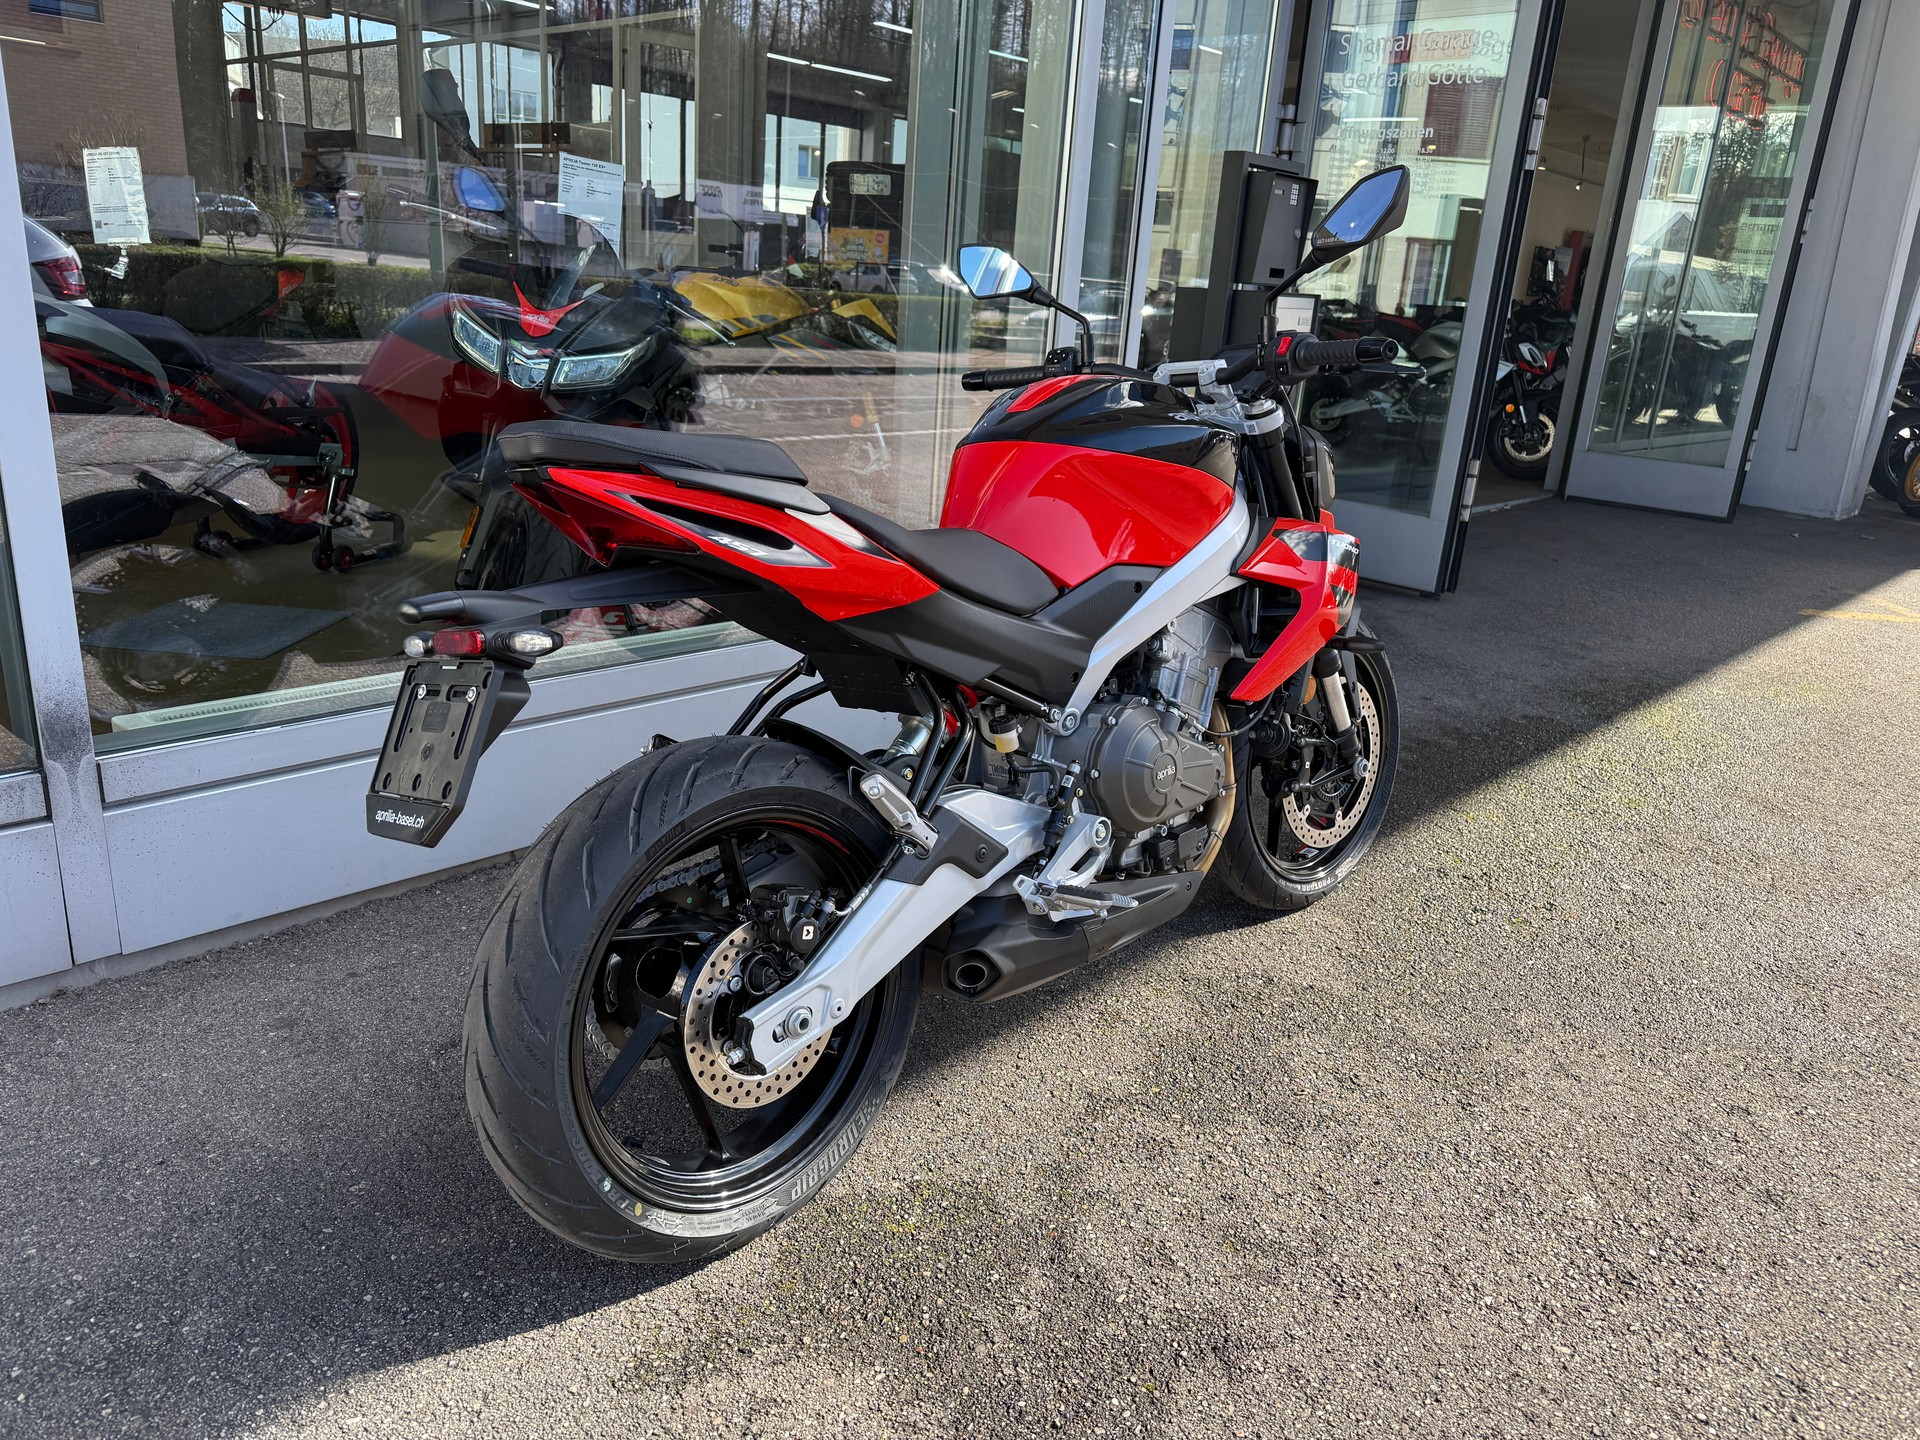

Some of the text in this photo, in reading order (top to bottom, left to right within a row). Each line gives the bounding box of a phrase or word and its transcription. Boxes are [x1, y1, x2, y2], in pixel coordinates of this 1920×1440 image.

[1420, 28, 1494, 50] Garage
[1342, 63, 1485, 89] Gerhard Götte
[526, 313, 550, 324] aprilia
[707, 535, 769, 556] 457
[1331, 538, 1360, 555] TUONO
[1156, 764, 1176, 781] aprilia
[375, 808, 425, 829] aprilia-basel.ch
[791, 1109, 867, 1202] EUROGRIP
